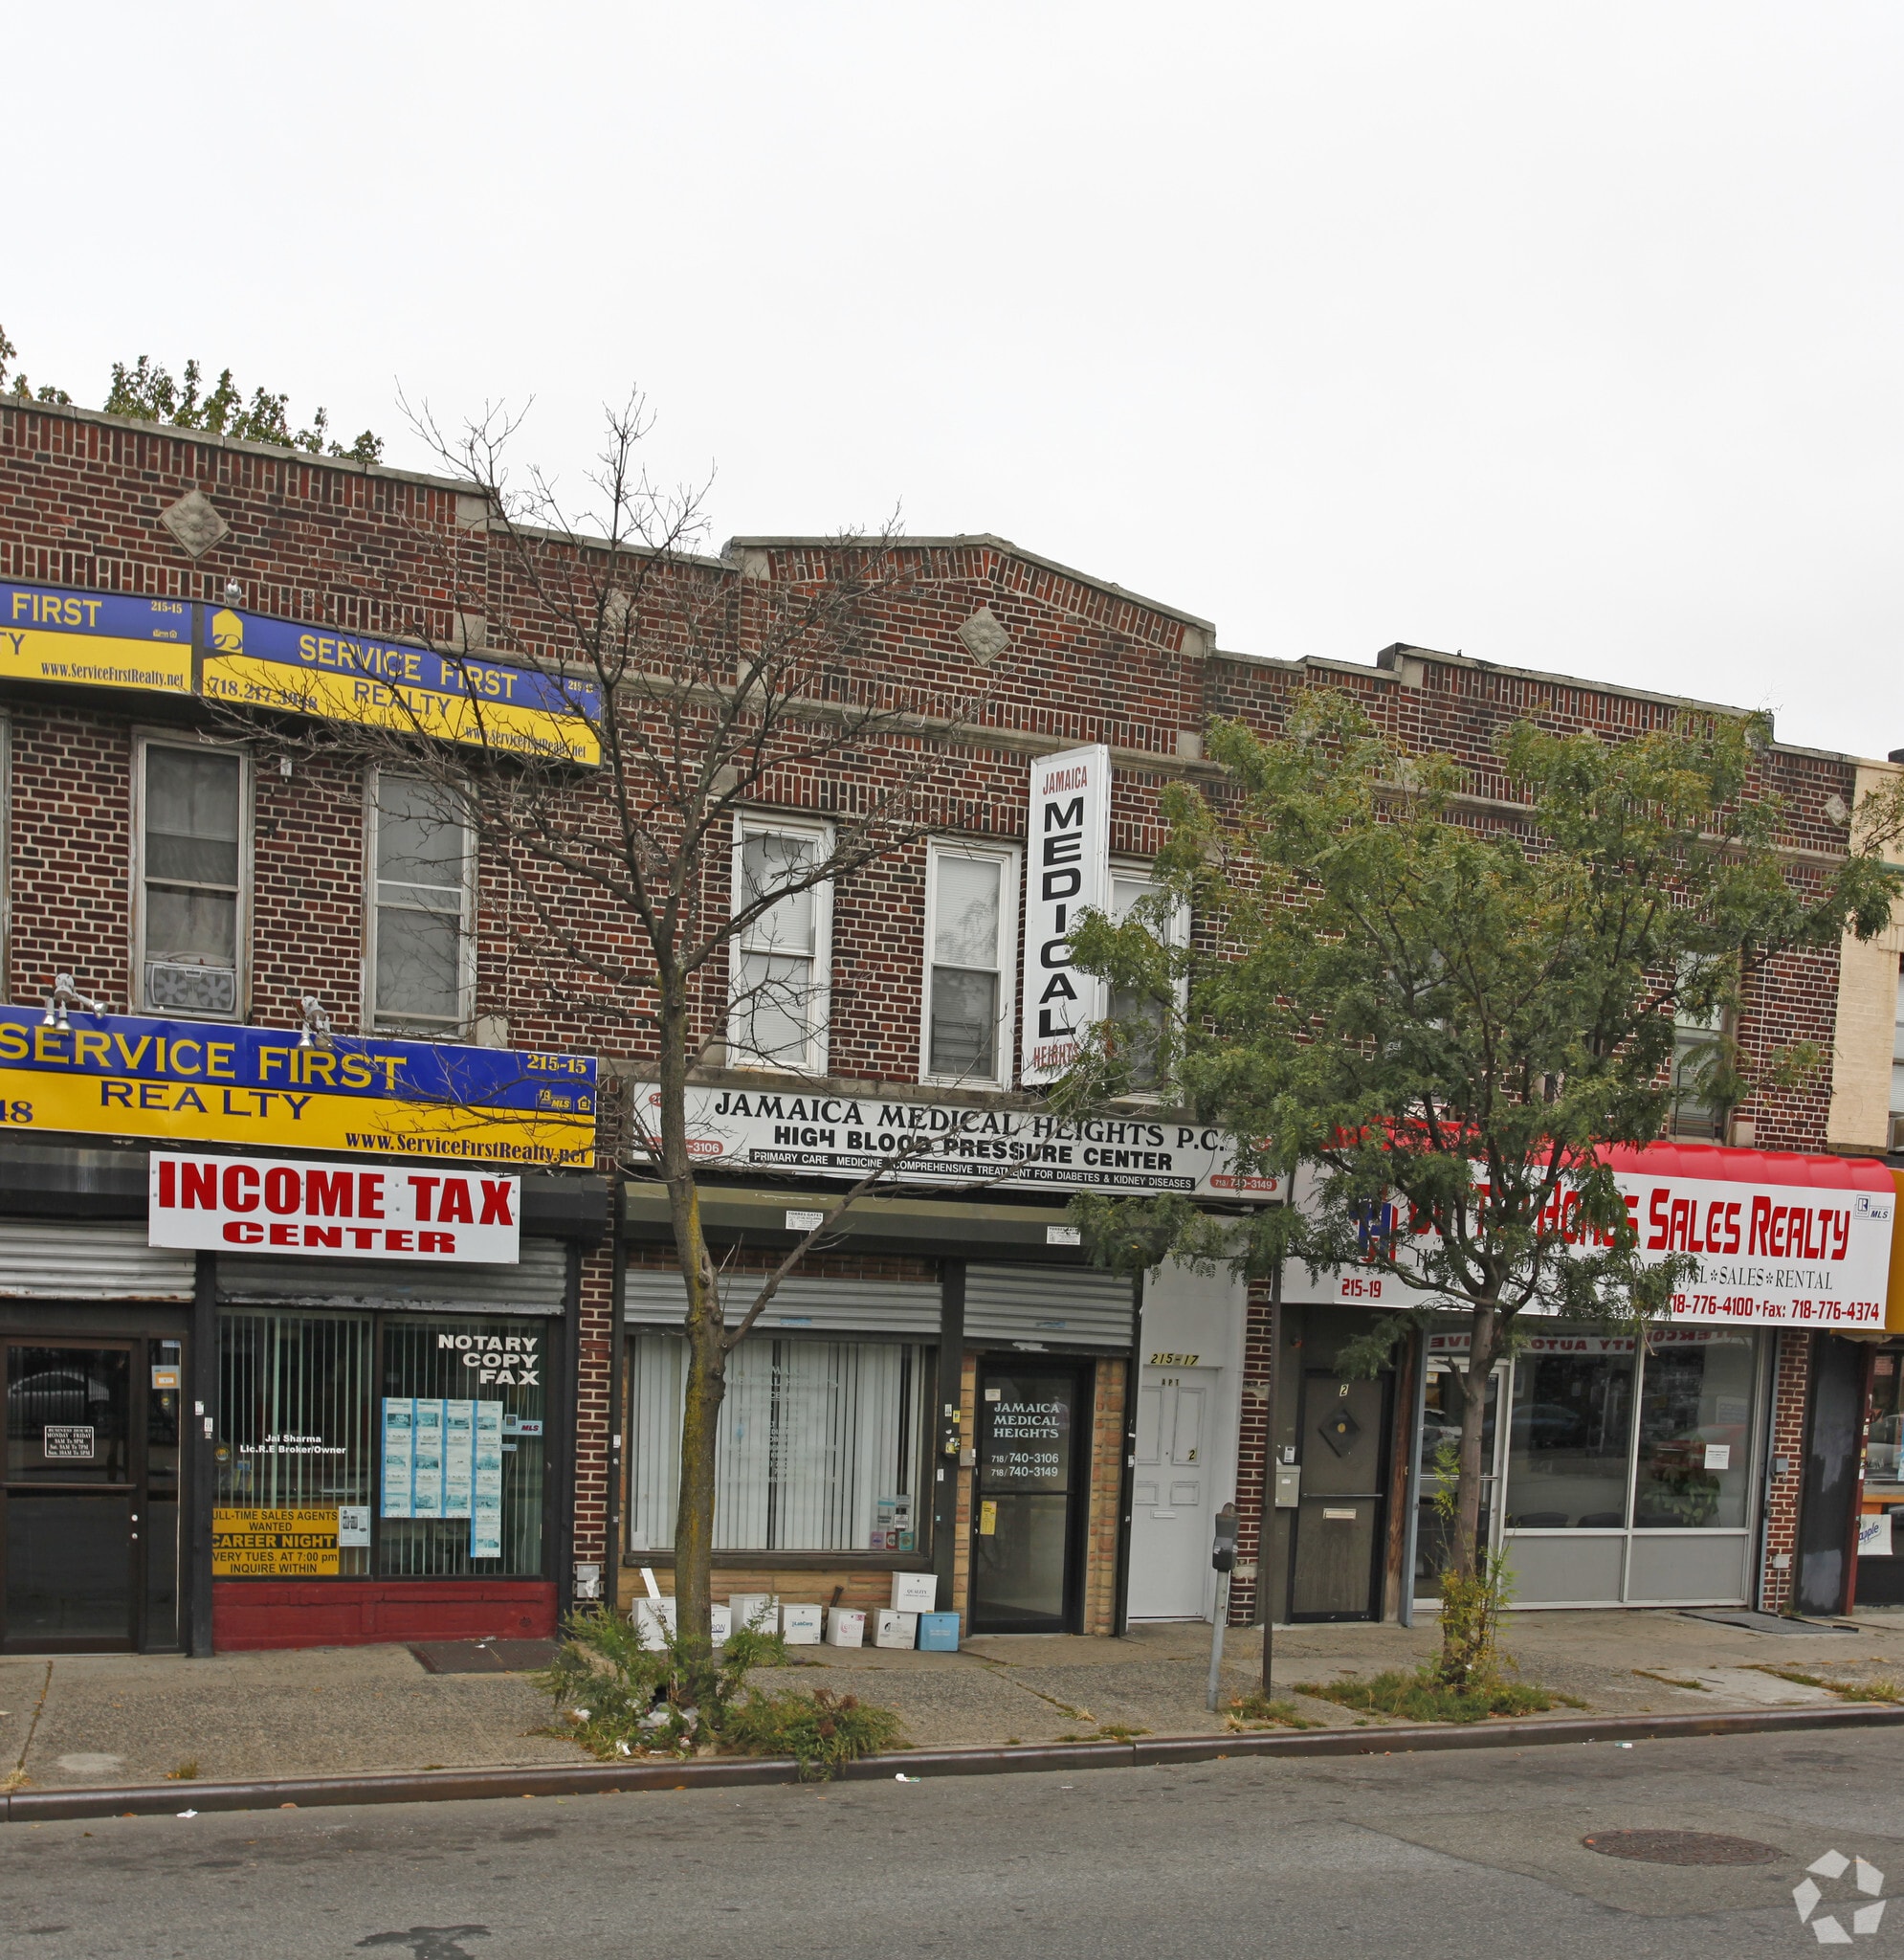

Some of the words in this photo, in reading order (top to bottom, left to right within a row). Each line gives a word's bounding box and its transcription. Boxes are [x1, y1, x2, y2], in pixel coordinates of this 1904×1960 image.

[11, 592, 102, 627] FIRST
[151, 600, 182, 613] 215-15
[41, 661, 184, 687] www.ServiceFirstRealty.net
[299, 635, 422, 681] SERVICE
[440, 660, 518, 699] FIRST
[354, 680, 452, 716] REALTY
[1043, 766, 1087, 795] JAMAICA
[1038, 796, 1084, 1038] MEDICAL
[0, 1022, 235, 1080] SERVICE
[258, 1045, 408, 1091] FIRST
[1034, 1043, 1079, 1068] HEIGHTS
[527, 1054, 587, 1074] 215-15
[100, 1080, 313, 1121] REALTY
[551, 1100, 570, 1108] MLS
[714, 1092, 864, 1125] JAMAICA
[877, 1104, 1019, 1135] MEDICAL
[1032, 1116, 1164, 1147] HEIGHTS
[1177, 1127, 1225, 1152] P.C.
[847, 1130, 934, 1154] BLOOD
[943, 1139, 1073, 1164] PRESSURE
[1083, 1147, 1172, 1171] CENTER
[754, 1151, 798, 1164] PRIMARY
[801, 1154, 829, 1165] CARE
[836, 1156, 883, 1168] MEDICINE
[895, 1160, 973, 1174] COMPREHENSIVE
[1034, 1170, 1053, 1179] FOR
[1056, 1171, 1100, 1183] DIABETES
[1103, 1174, 1110, 1183] &
[1114, 1175, 1146, 1186] KIDNEY
[1148, 1177, 1191, 1189] DISEASES
[158, 1161, 385, 1219] INCOME
[408, 1175, 513, 1226] TAX
[1871, 1210, 1889, 1218] MLS
[1647, 1188, 1742, 1255] SALES
[1748, 1195, 1850, 1260] REALTY
[222, 1221, 455, 1254] CENTER
[1719, 1265, 1764, 1287] SALES
[1776, 1269, 1833, 1291] RENTAL
[1341, 1278, 1382, 1298] 215-19
[1762, 1301, 1786, 1318] Fax:
[1791, 1299, 1880, 1322] 718-776-4374
[438, 1334, 539, 1352] NOTARY
[462, 1352, 539, 1368] COPY
[1151, 1353, 1199, 1365] 215-17
[479, 1370, 540, 1385] FAX
[1162, 1378, 1179, 1387] APT
[1340, 1384, 1349, 1396] 2
[994, 1402, 1060, 1414] JAMAICA
[994, 1415, 1060, 1425] MEDICAL
[283, 1435, 321, 1443] Sharma
[993, 1428, 1059, 1438] HEIGHTS
[278, 1445, 346, 1454] Broker/Owner
[1188, 1449, 1196, 1460] 2
[1009, 1453, 1059, 1463] 740-3106
[1009, 1466, 1058, 1477] 740-3149
[212, 1510, 258, 1520] ULL-TIME
[261, 1510, 294, 1520] SALES
[297, 1511, 338, 1521] AGENTS
[249, 1522, 292, 1531] WANTED
[212, 1535, 277, 1548] CAREER
[282, 1535, 335, 1548] NIGHT
[212, 1552, 242, 1561] VERY
[245, 1552, 277, 1562] TUES.
[280, 1552, 294, 1561] AT
[298, 1552, 319, 1561] 7:00
[321, 1554, 338, 1563] pm
[230, 1564, 276, 1573] INQUIRE
[279, 1564, 317, 1572] WITHIN
